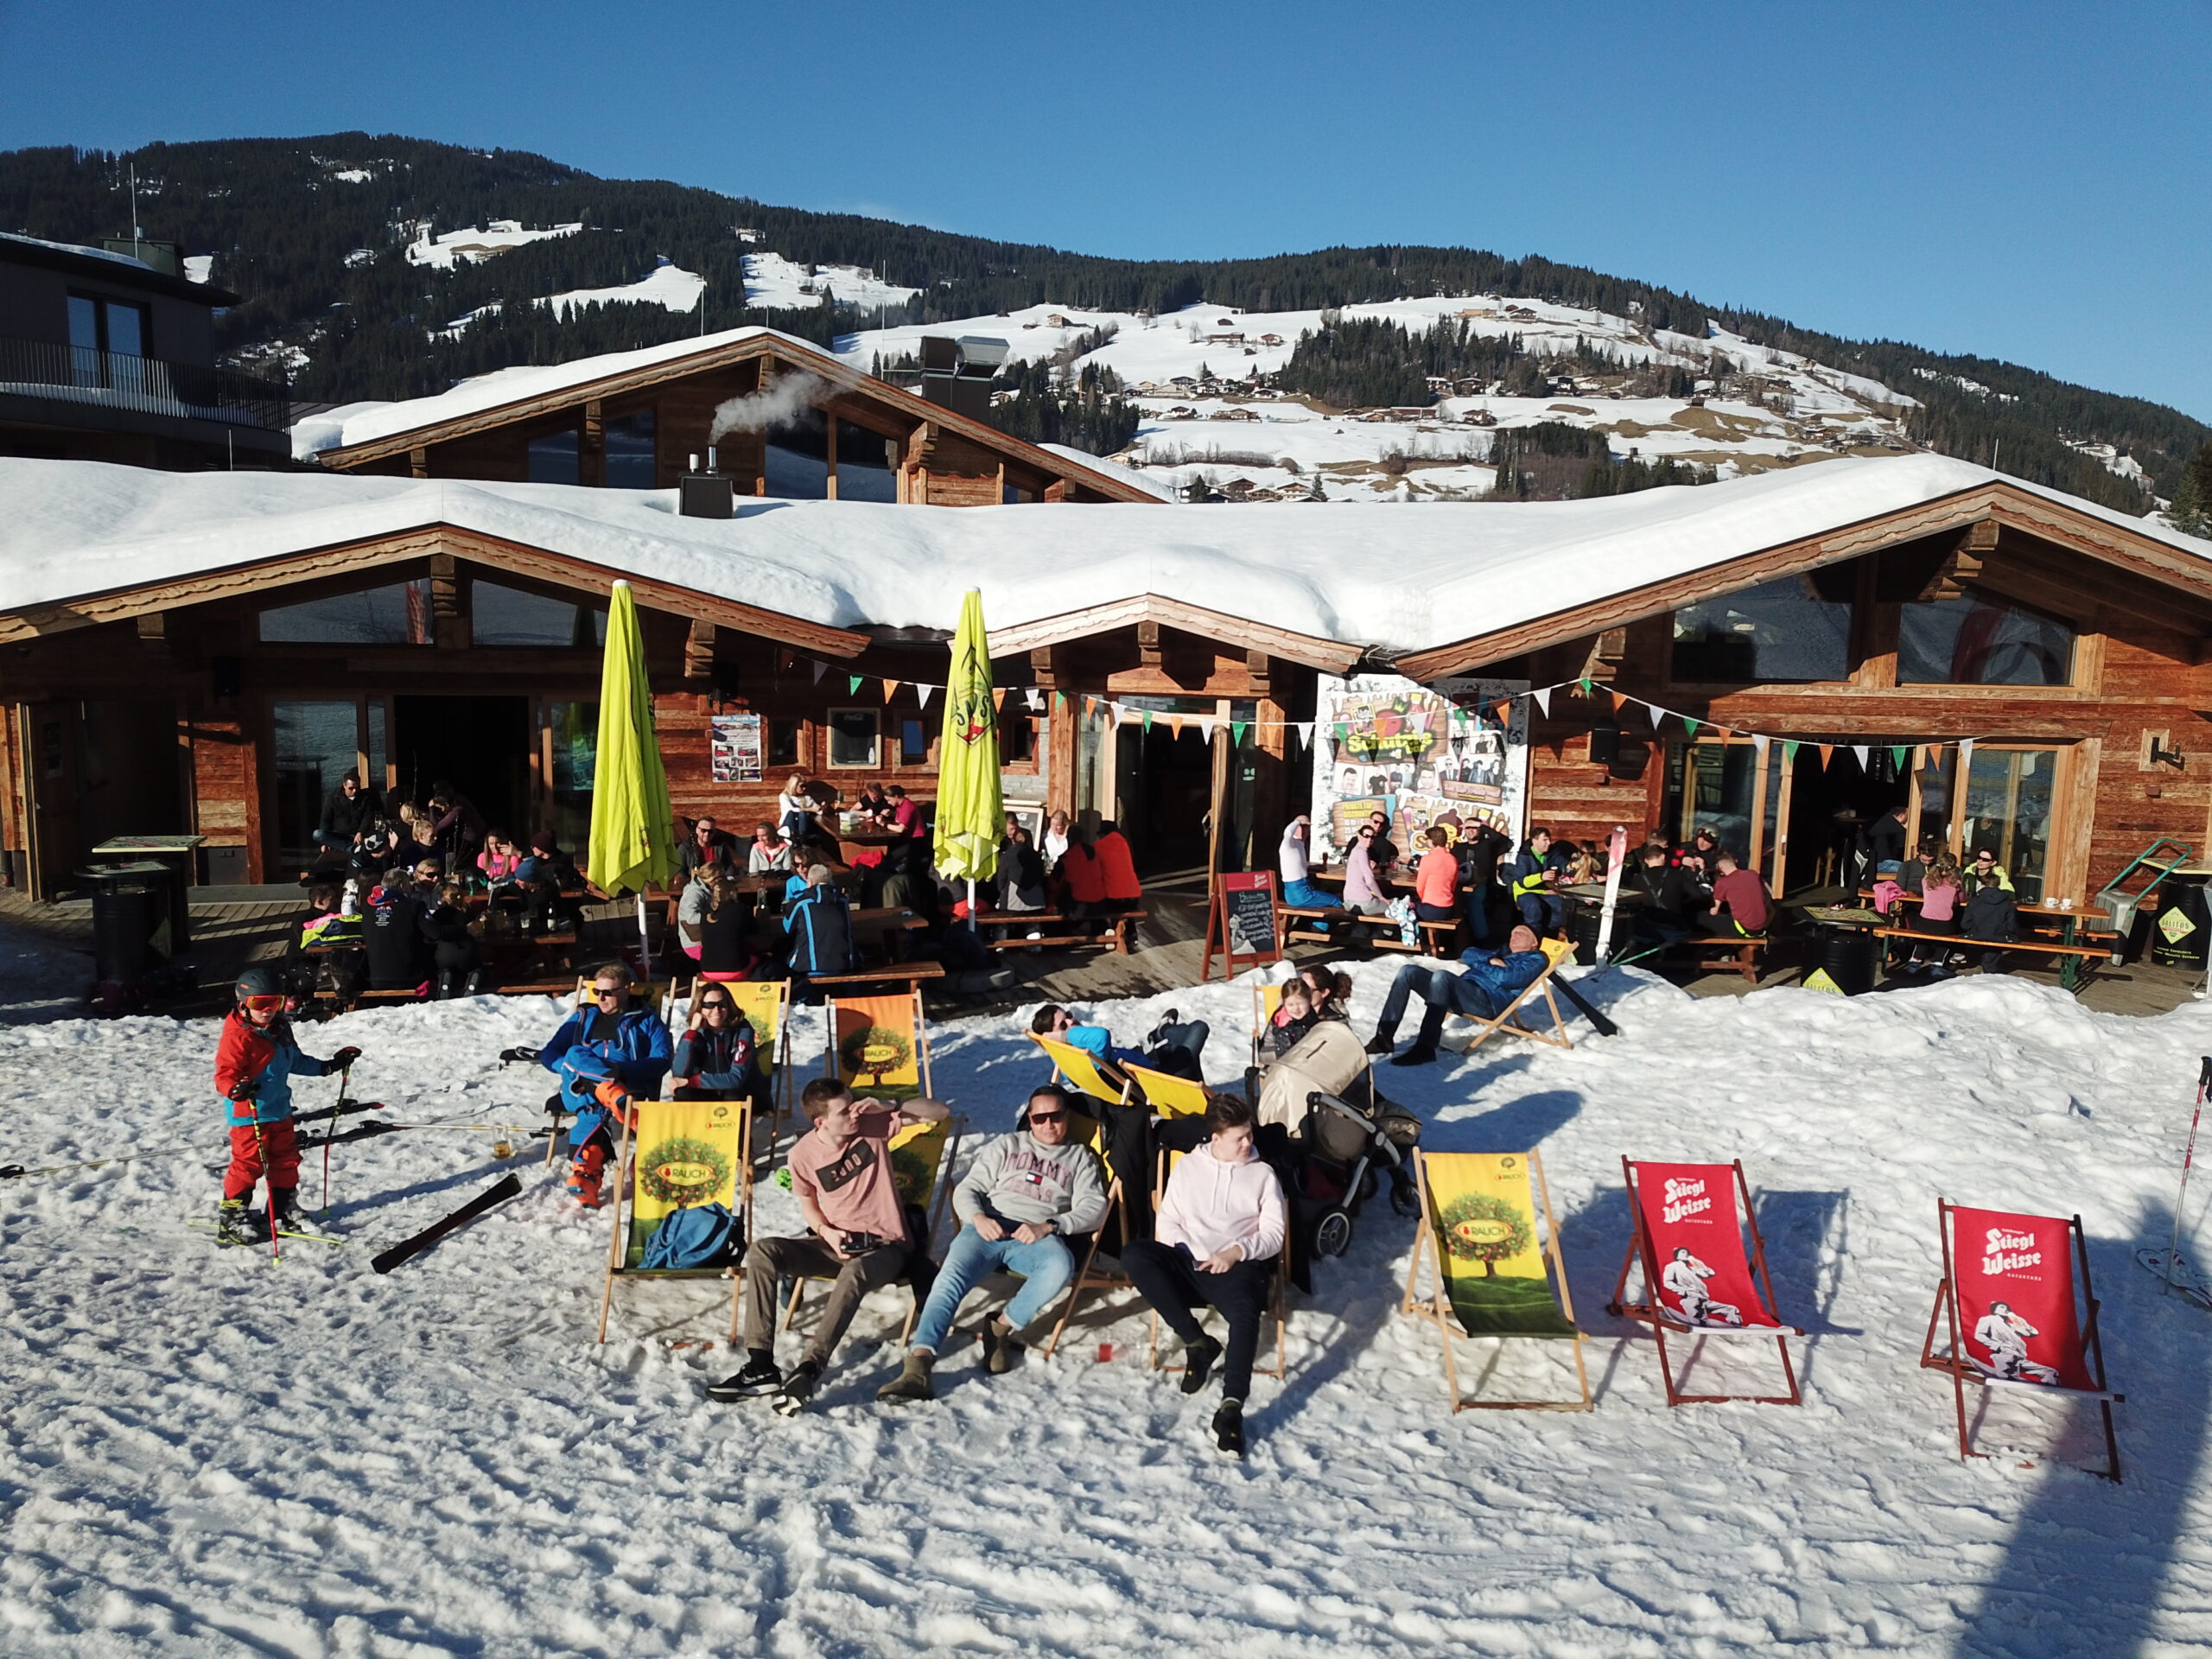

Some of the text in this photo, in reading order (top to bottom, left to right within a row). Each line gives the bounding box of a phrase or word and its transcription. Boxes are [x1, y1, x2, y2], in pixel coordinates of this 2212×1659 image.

[2161, 918, 2190, 930] SALITOS
[672, 1168, 706, 1179] RAUCH
[1005, 1151, 1073, 1190] TOMMY
[1664, 1179, 1705, 1204] Stiegl
[1662, 1198, 1711, 1224] Weisse
[1471, 1226, 1505, 1236] RAUCH
[1986, 1228, 2035, 1255] Stiegl
[1981, 1253, 2042, 1275] Weisse
